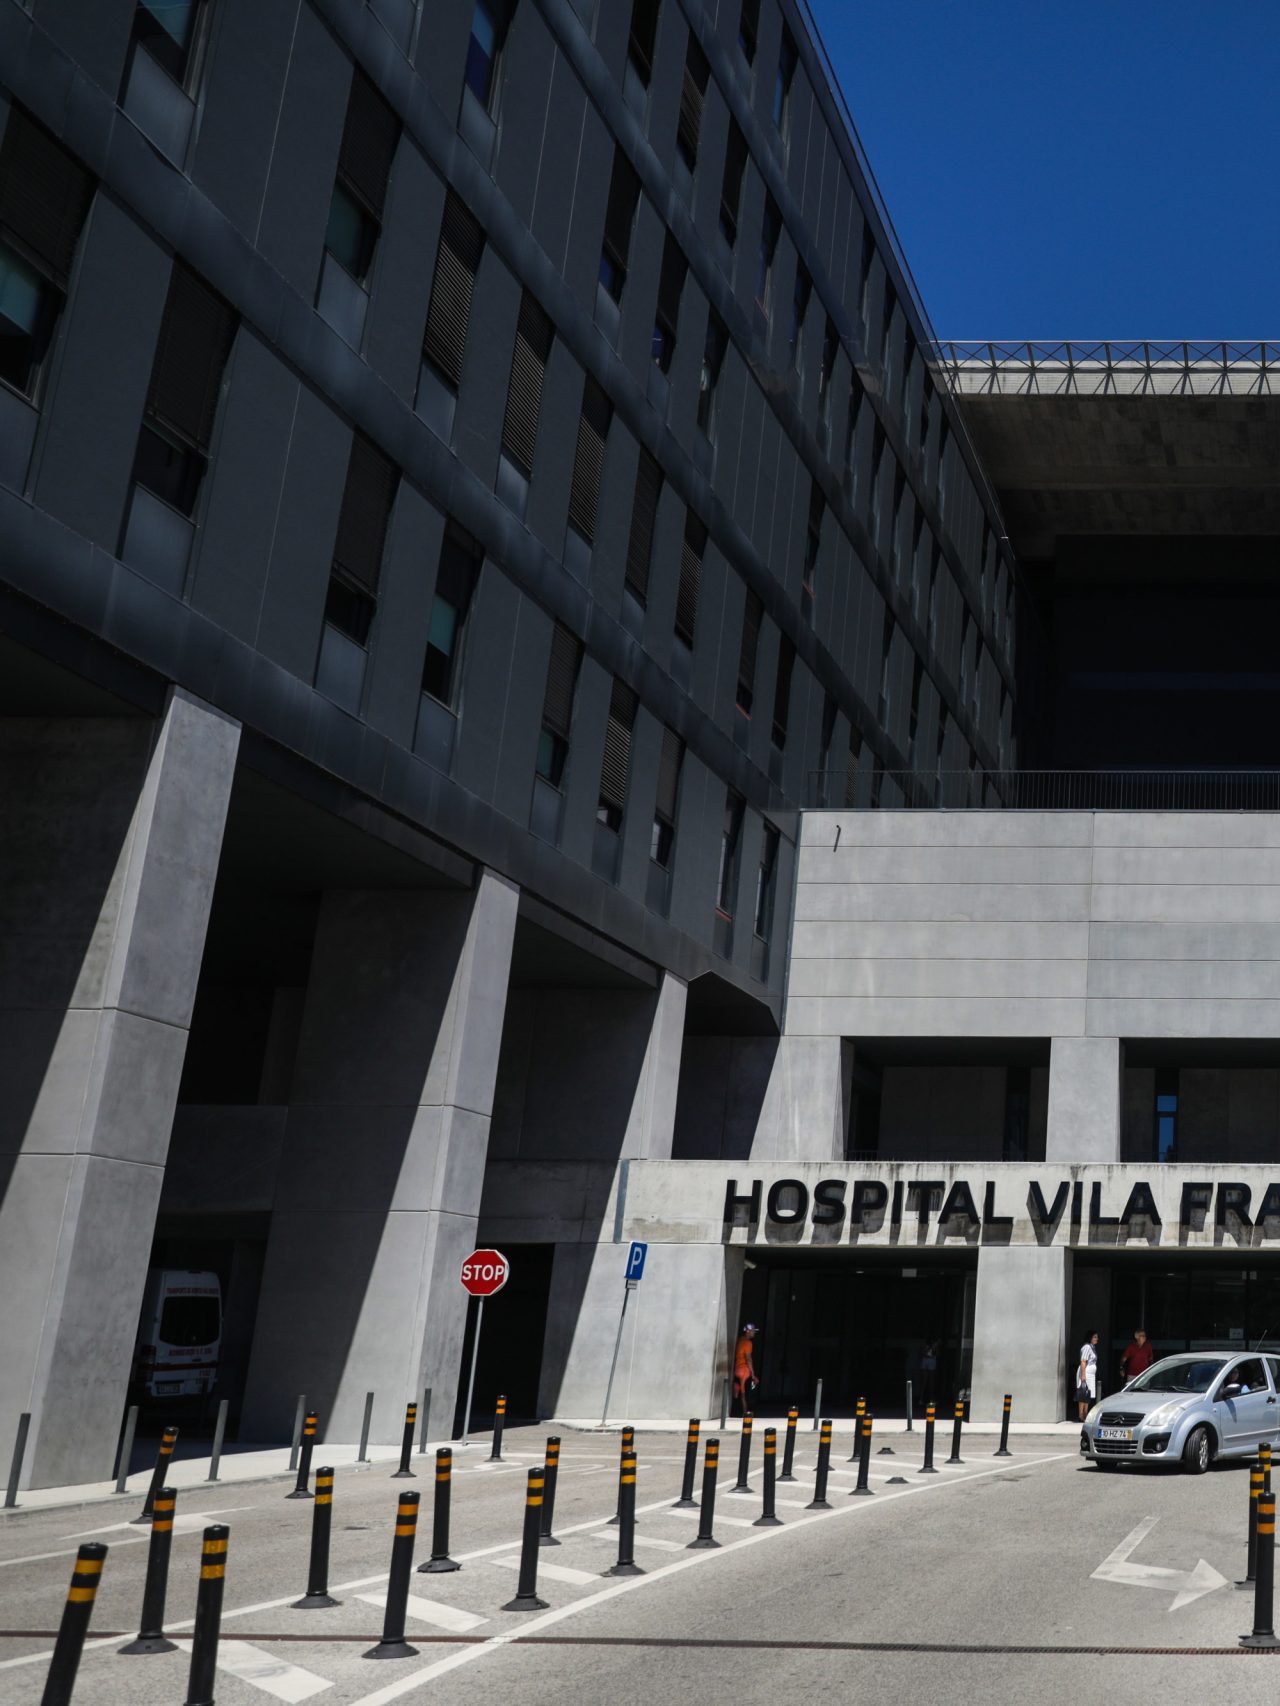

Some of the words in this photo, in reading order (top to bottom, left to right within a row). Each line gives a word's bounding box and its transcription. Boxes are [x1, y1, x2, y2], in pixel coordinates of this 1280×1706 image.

[722, 1179, 1014, 1225] HOSPITAL
[1028, 1181, 1162, 1226] VILA
[462, 1264, 505, 1281] STOP
[630, 1246, 643, 1275] P
